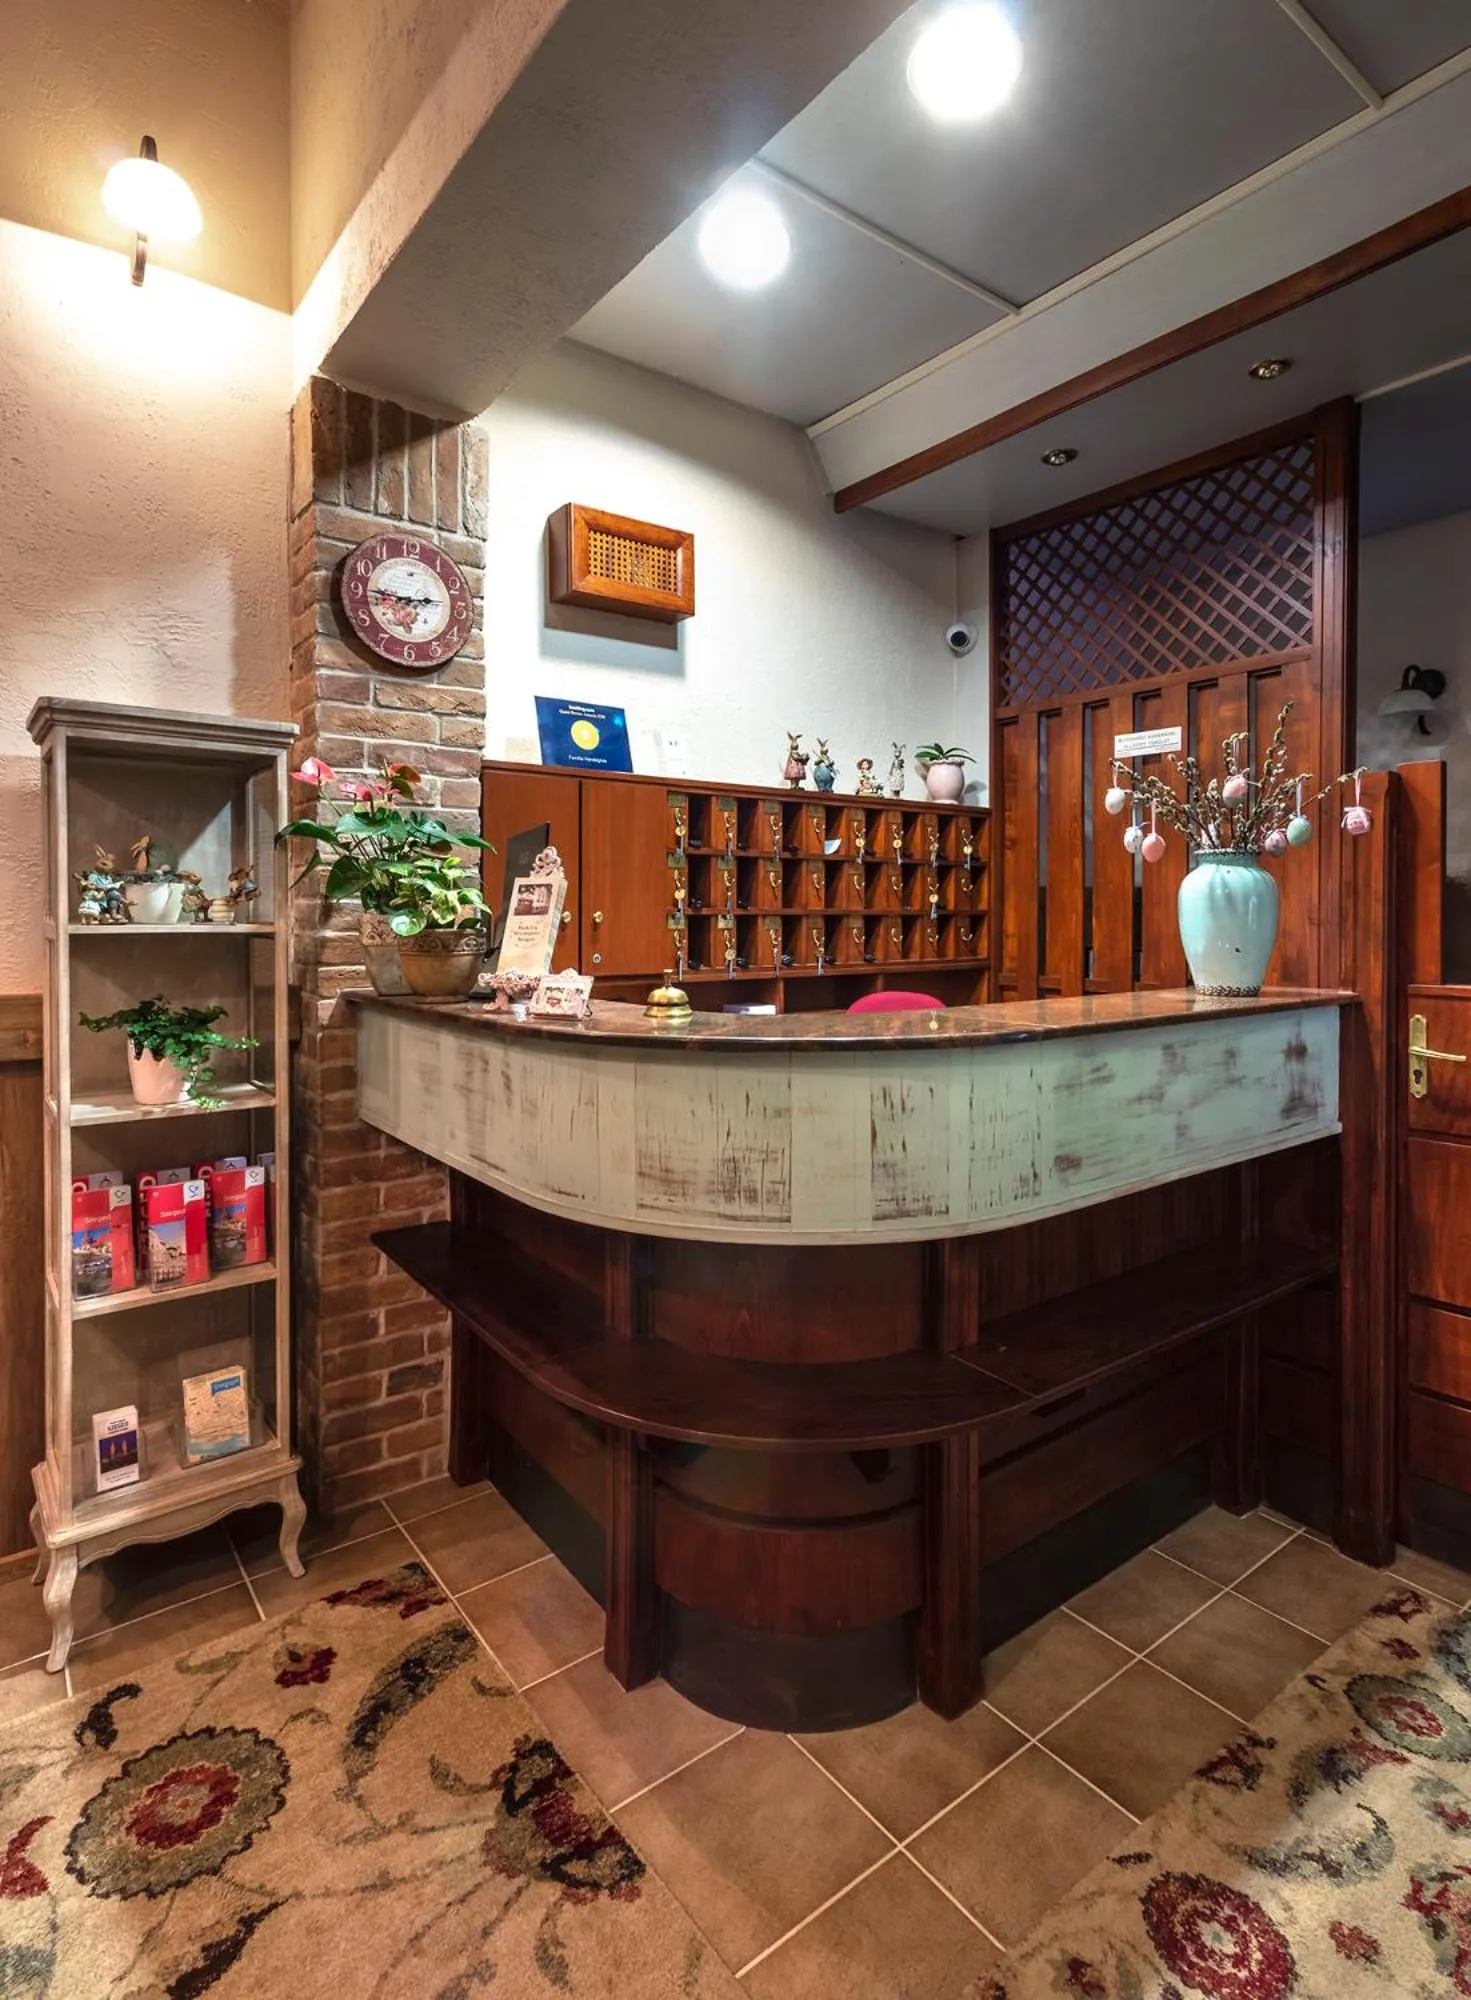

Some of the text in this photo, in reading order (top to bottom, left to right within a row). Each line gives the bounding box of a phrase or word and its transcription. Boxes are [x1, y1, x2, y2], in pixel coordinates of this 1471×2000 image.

[376, 542, 387, 560] 11
[402, 539, 421, 559] 12
[356, 559, 372, 577] 10
[435, 557, 442, 573] 1
[350, 581, 363, 599] 9
[448, 577, 461, 595] 2
[358, 609, 371, 626] 8
[378, 634, 390, 651] 7
[446, 626, 459, 642] 4
[403, 643, 417, 661] 6
[429, 641, 442, 657] 5
